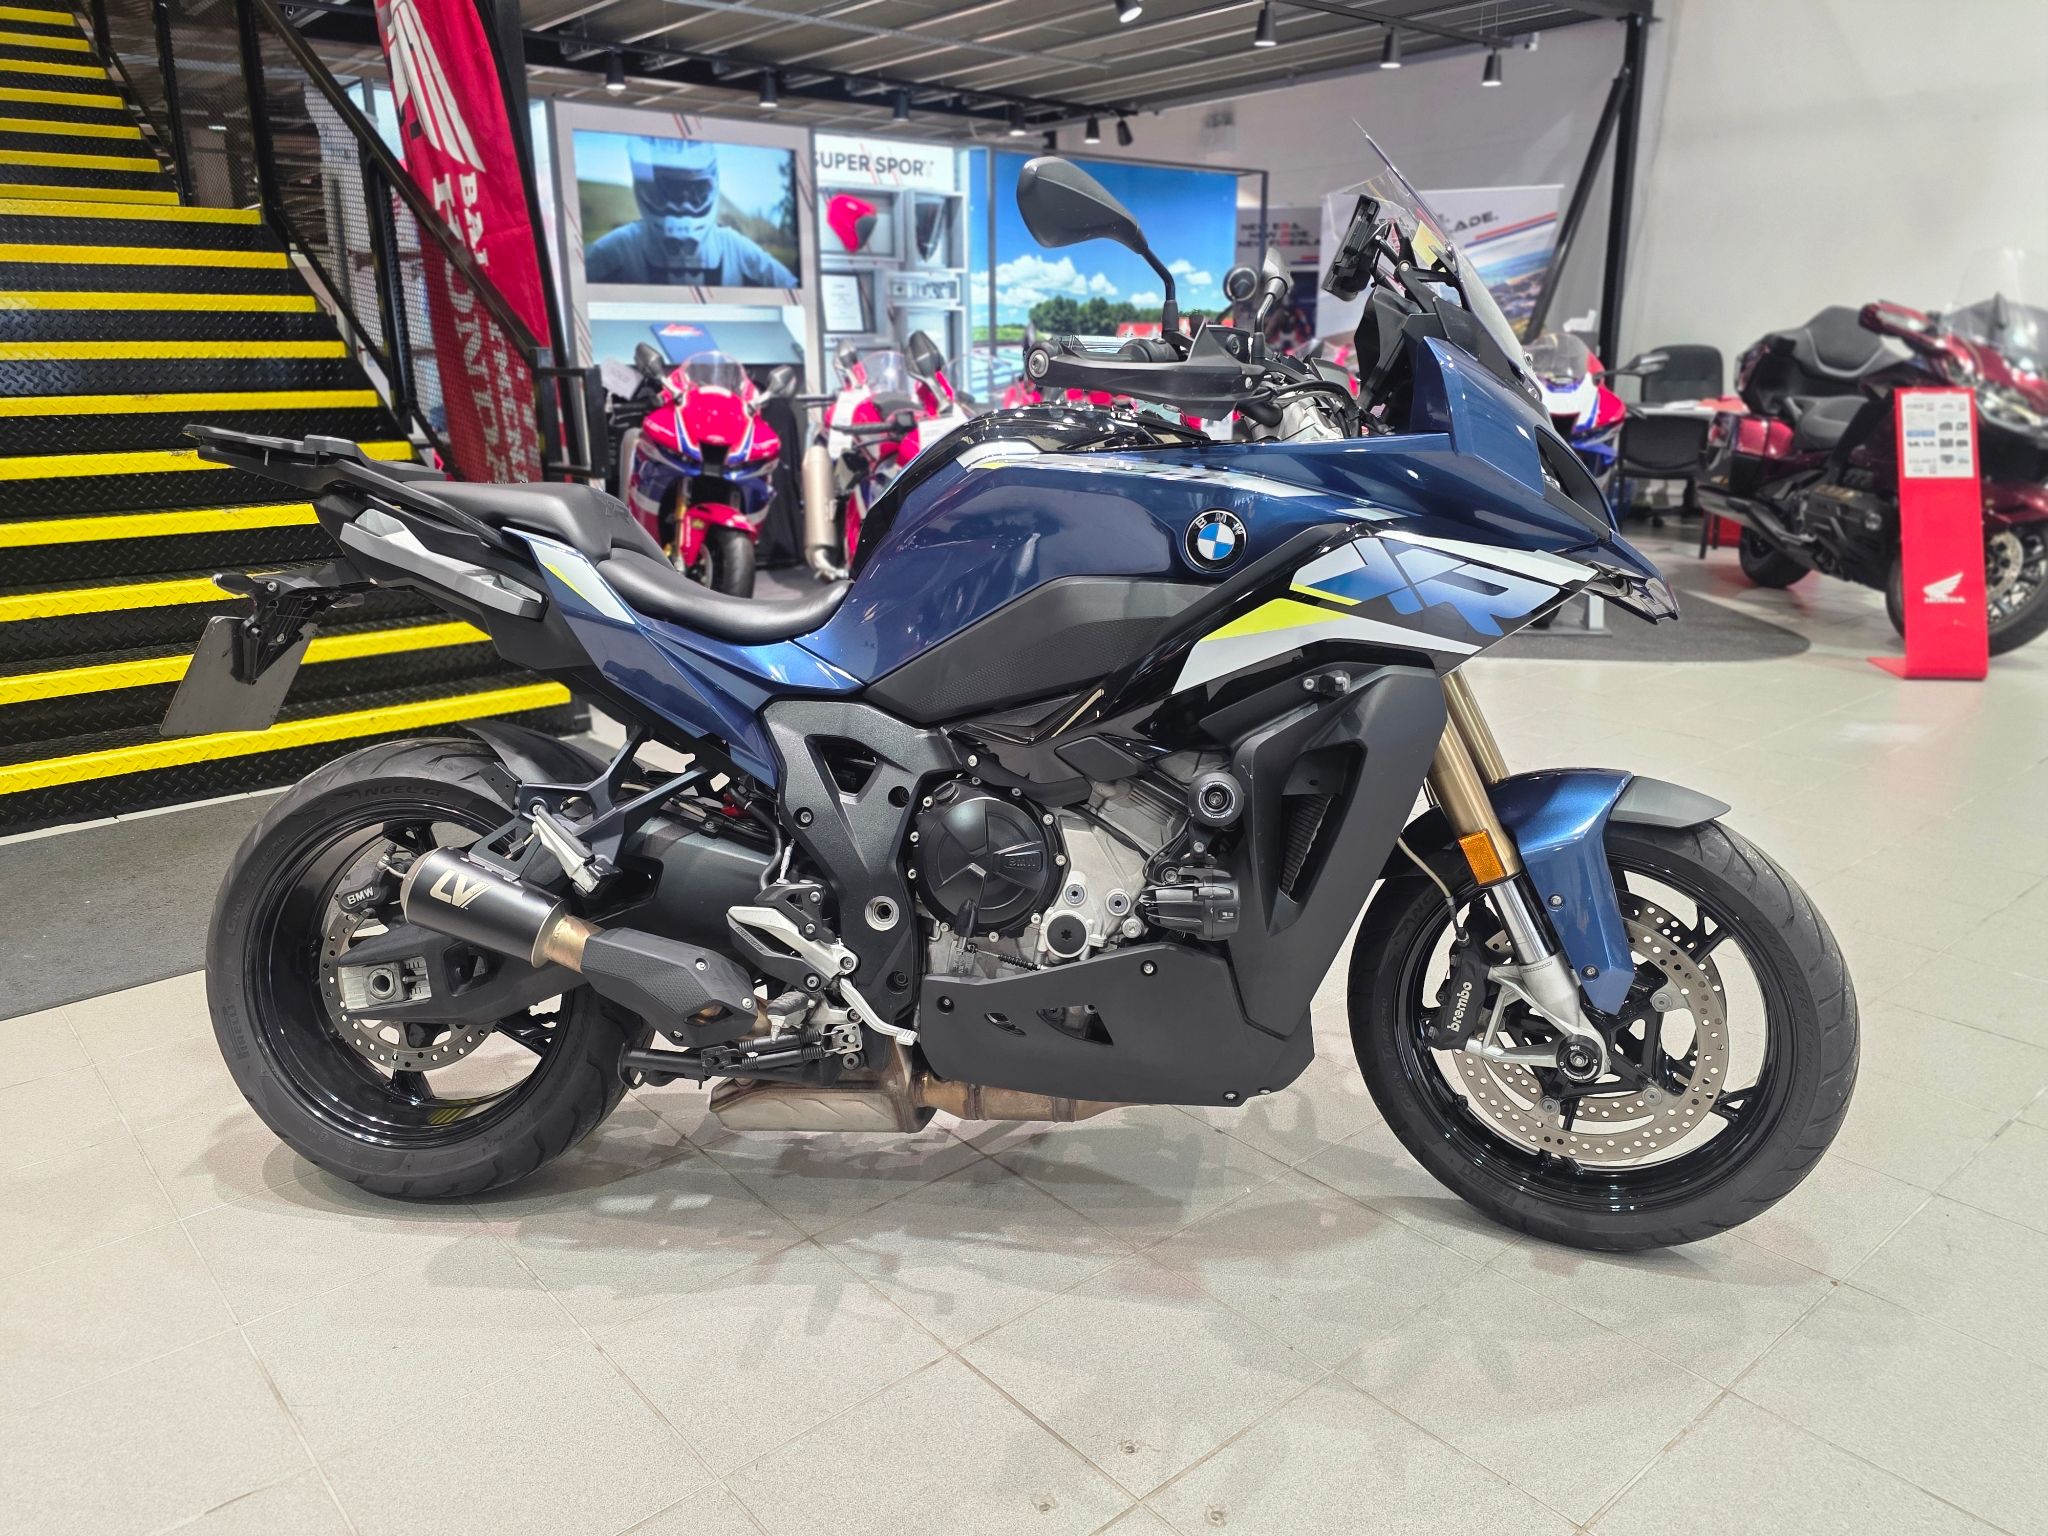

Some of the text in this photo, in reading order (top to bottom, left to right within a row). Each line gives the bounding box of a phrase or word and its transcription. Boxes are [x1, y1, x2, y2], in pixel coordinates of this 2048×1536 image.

[1196, 512, 1244, 535] BMW
[346, 886, 374, 905] BMW
[1446, 981, 1473, 1033] brembo
